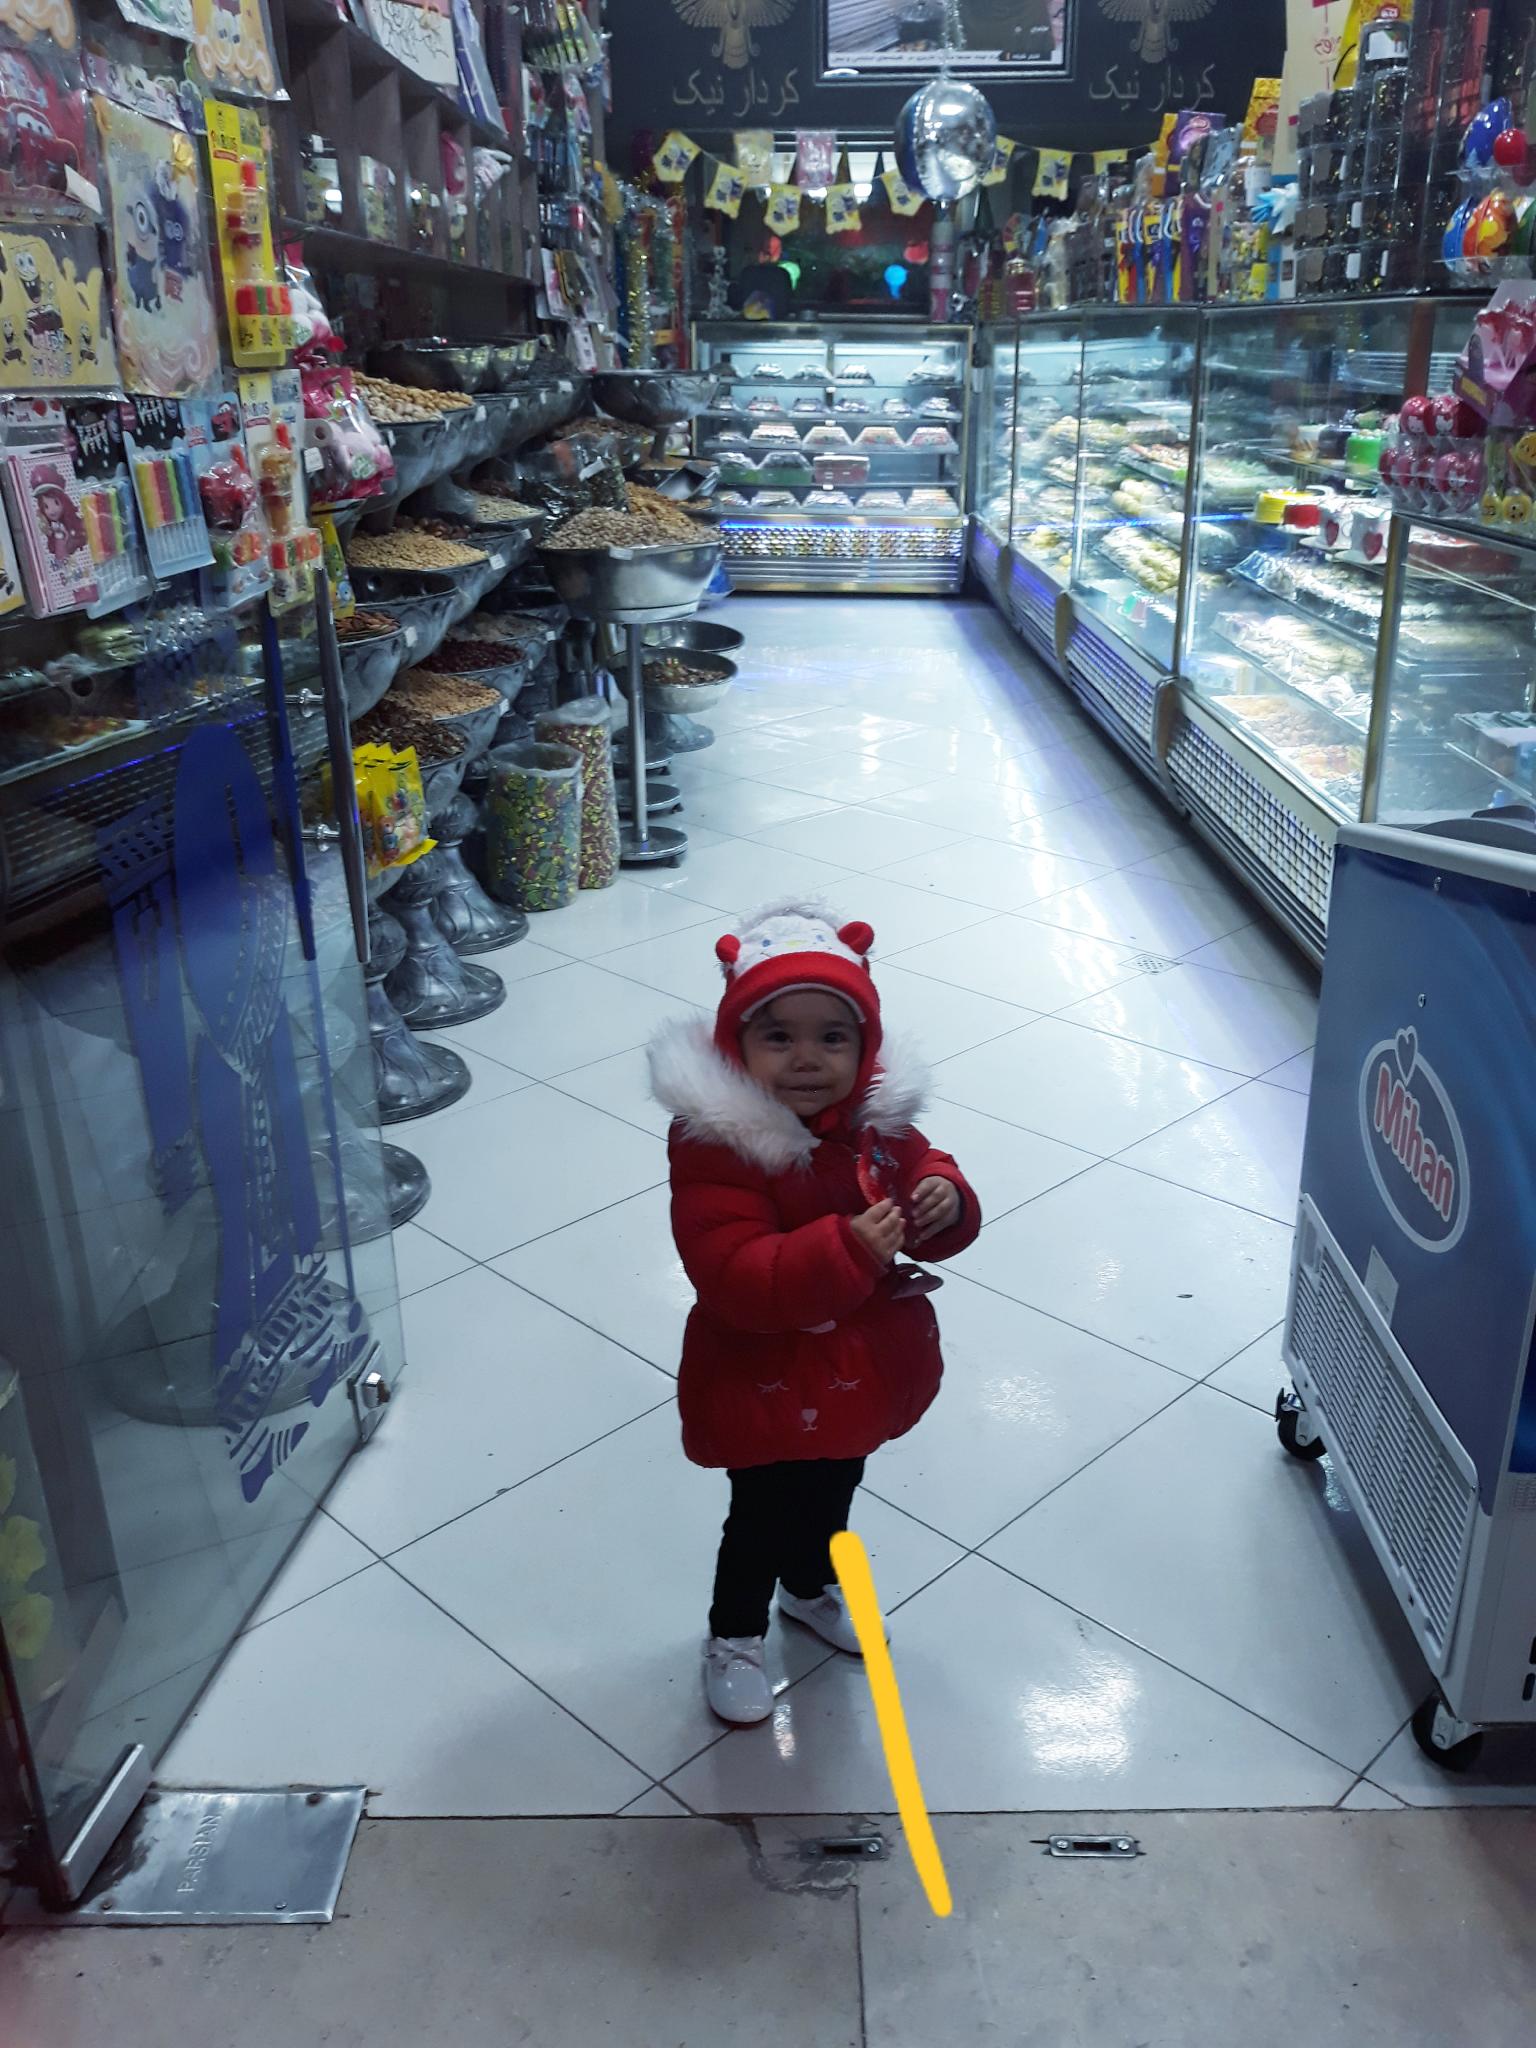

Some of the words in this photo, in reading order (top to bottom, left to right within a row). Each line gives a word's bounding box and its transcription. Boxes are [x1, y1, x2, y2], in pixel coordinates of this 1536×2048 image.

[673, 69, 724, 115] نیک
[733, 67, 799, 116] کردار
[1089, 64, 1139, 111] نیک
[1147, 63, 1215, 112] کردار
[1375, 1062, 1454, 1222] Mihan
[176, 1815, 222, 1892] PARSIAN
